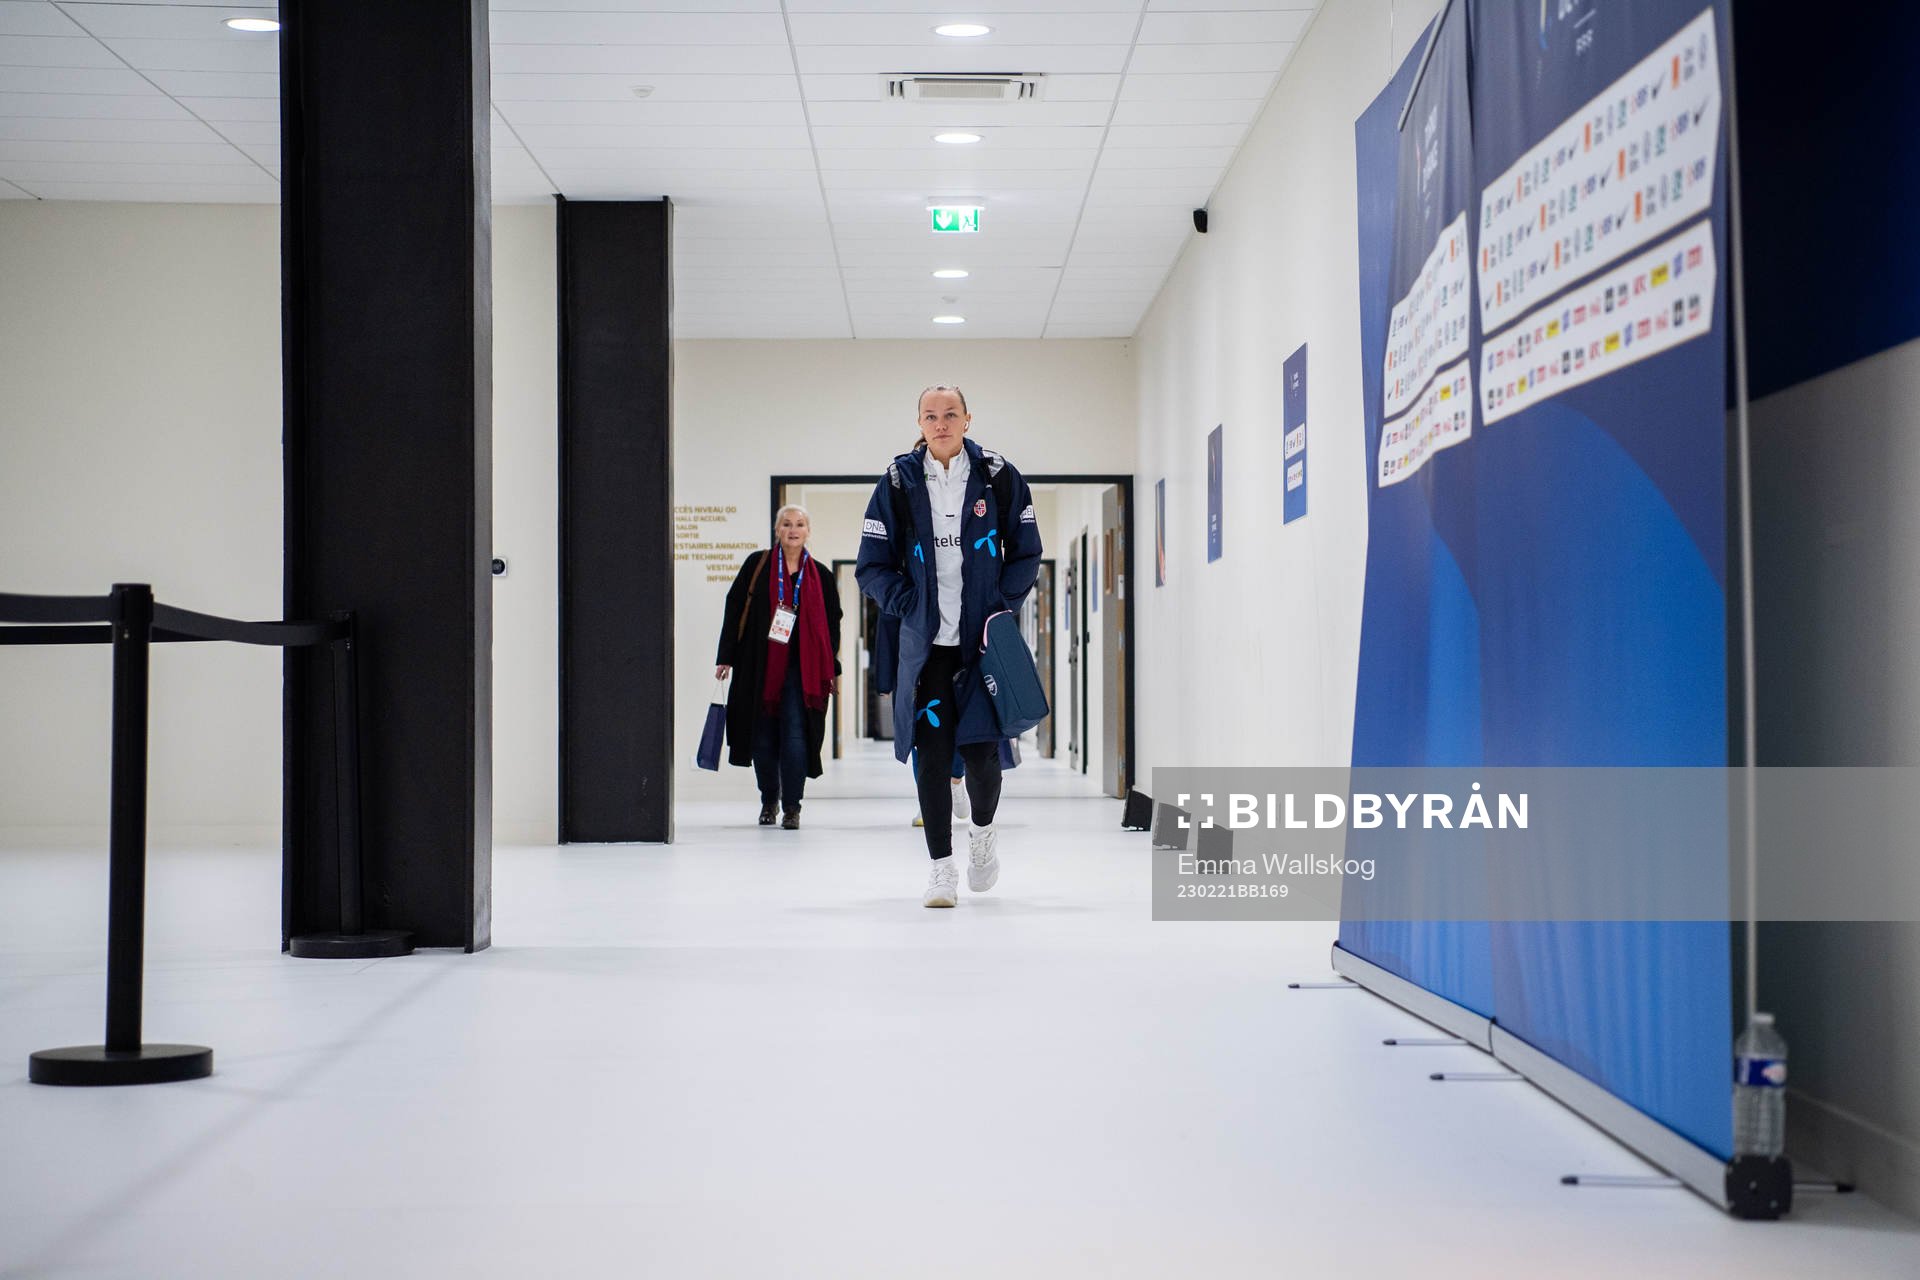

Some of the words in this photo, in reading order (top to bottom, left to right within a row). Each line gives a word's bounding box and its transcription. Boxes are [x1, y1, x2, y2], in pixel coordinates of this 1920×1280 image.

[674, 504, 693, 514] CCÈS
[695, 506, 723, 514] NIVEAU
[865, 520, 885, 533] DNB
[934, 534, 961, 548] tele
[674, 553, 689, 561] ONE
[692, 553, 734, 561] TECHNIQUE
[706, 575, 736, 583] INFIRM
